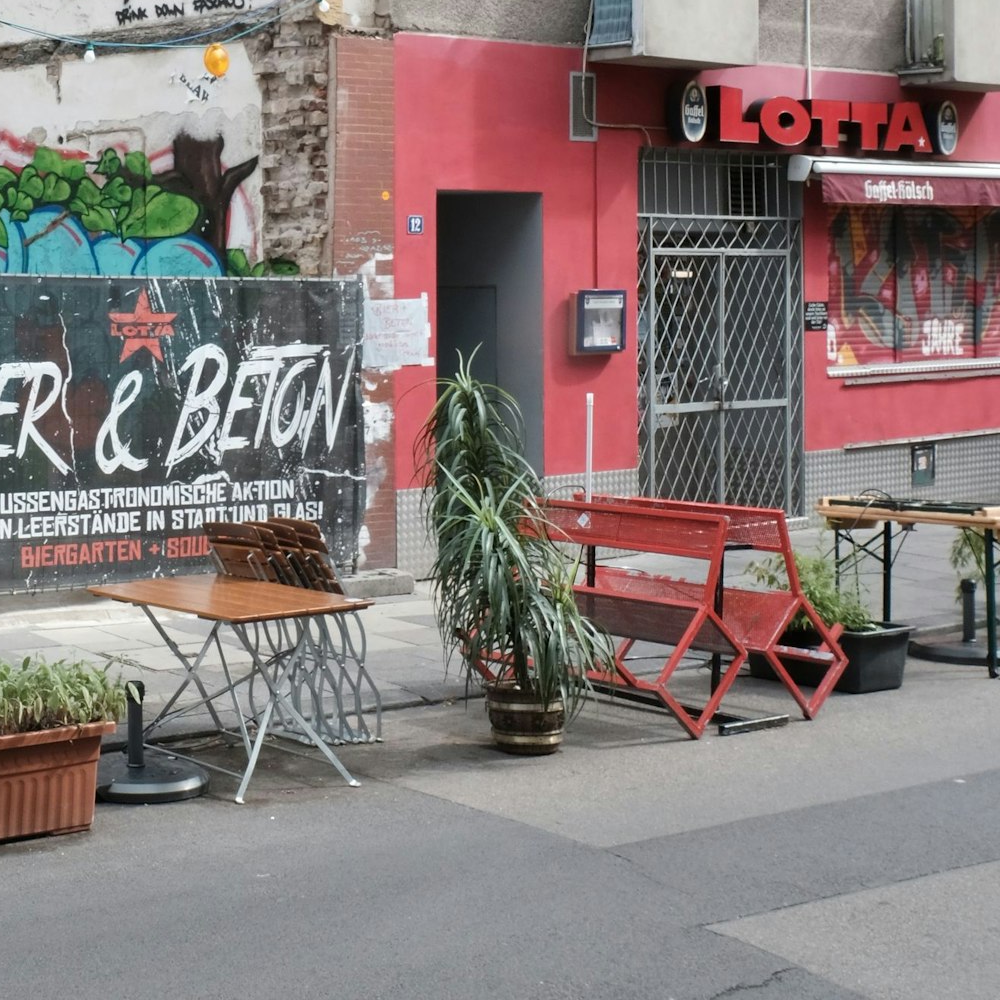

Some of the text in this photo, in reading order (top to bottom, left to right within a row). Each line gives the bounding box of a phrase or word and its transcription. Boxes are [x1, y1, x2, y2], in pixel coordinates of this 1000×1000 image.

[684, 104, 704, 118] Gaffel
[719, 85, 933, 153] LOTTA
[411, 217, 421, 232] 12
[95, 370, 149, 475] &
[165, 341, 358, 479] BETON
[231, 479, 295, 502] AKTION
[17, 510, 142, 539] LEERSTÄNDE
[146, 509, 165, 531] IN
[171, 507, 227, 530] STADT
[232, 504, 268, 524] UND
[273, 501, 324, 520] GLAS!
[21, 540, 142, 568] BIERGARTEN
[149, 543, 160, 555] +
